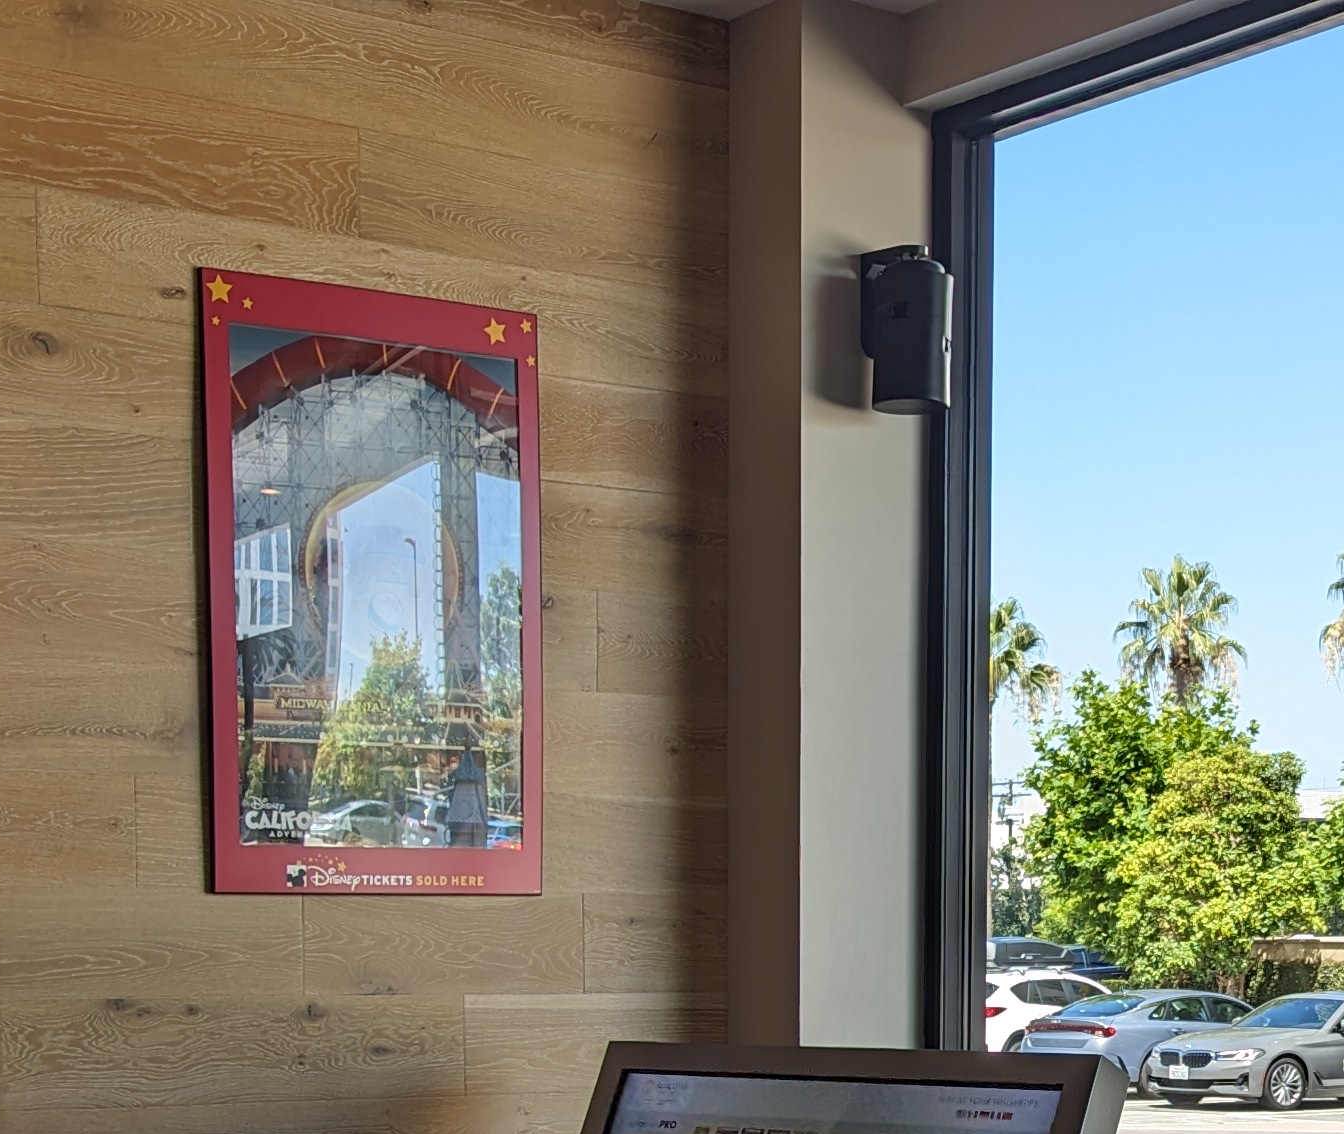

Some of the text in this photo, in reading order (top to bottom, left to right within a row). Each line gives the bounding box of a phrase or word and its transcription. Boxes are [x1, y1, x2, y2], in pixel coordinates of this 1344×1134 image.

[361, 874, 413, 886] TICKETS
[415, 875, 448, 886] SOLD
[451, 875, 485, 887] HERE
[659, 1120, 677, 1129] PRO
